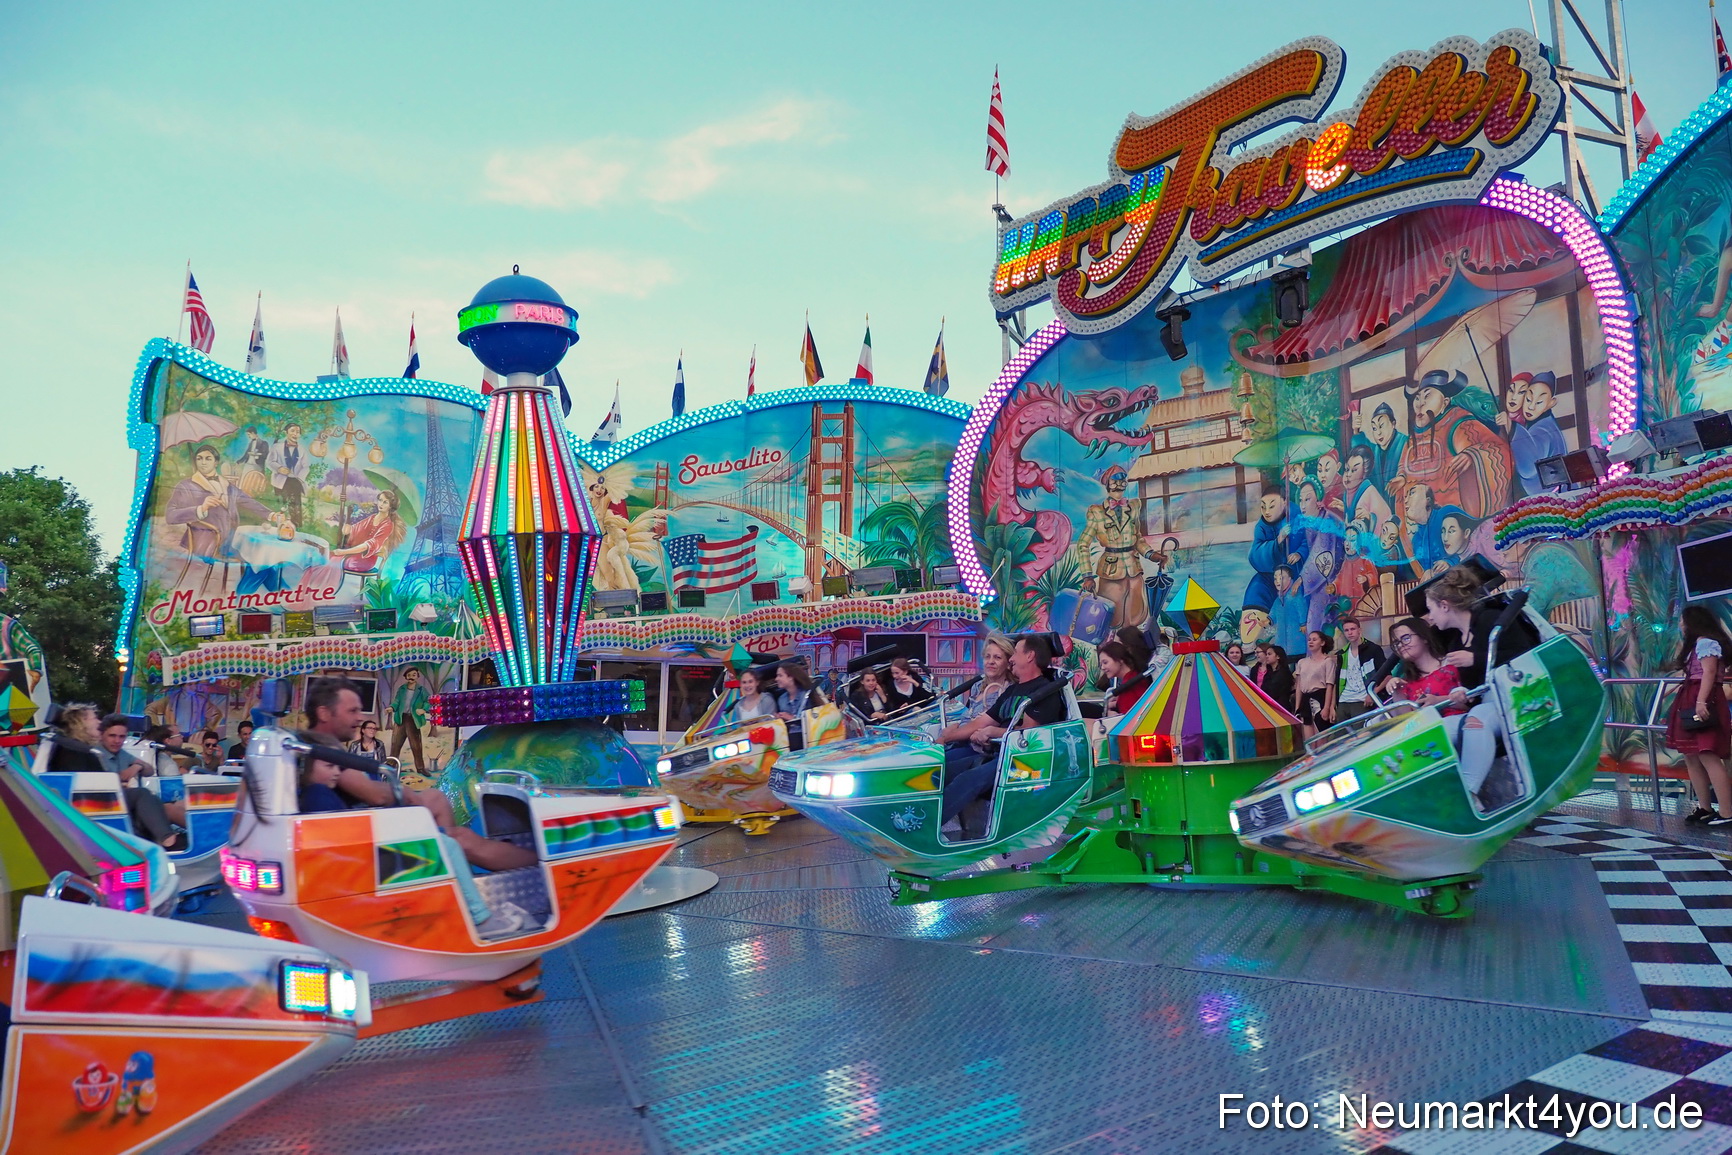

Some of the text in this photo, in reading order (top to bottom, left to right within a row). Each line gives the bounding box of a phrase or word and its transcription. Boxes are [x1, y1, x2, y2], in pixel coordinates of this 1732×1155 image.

[1057, 45, 1536, 316] Traveller
[515, 303, 565, 325] PARIS
[678, 446, 782, 485] Sausalito
[150, 584, 337, 625] Montmartre
